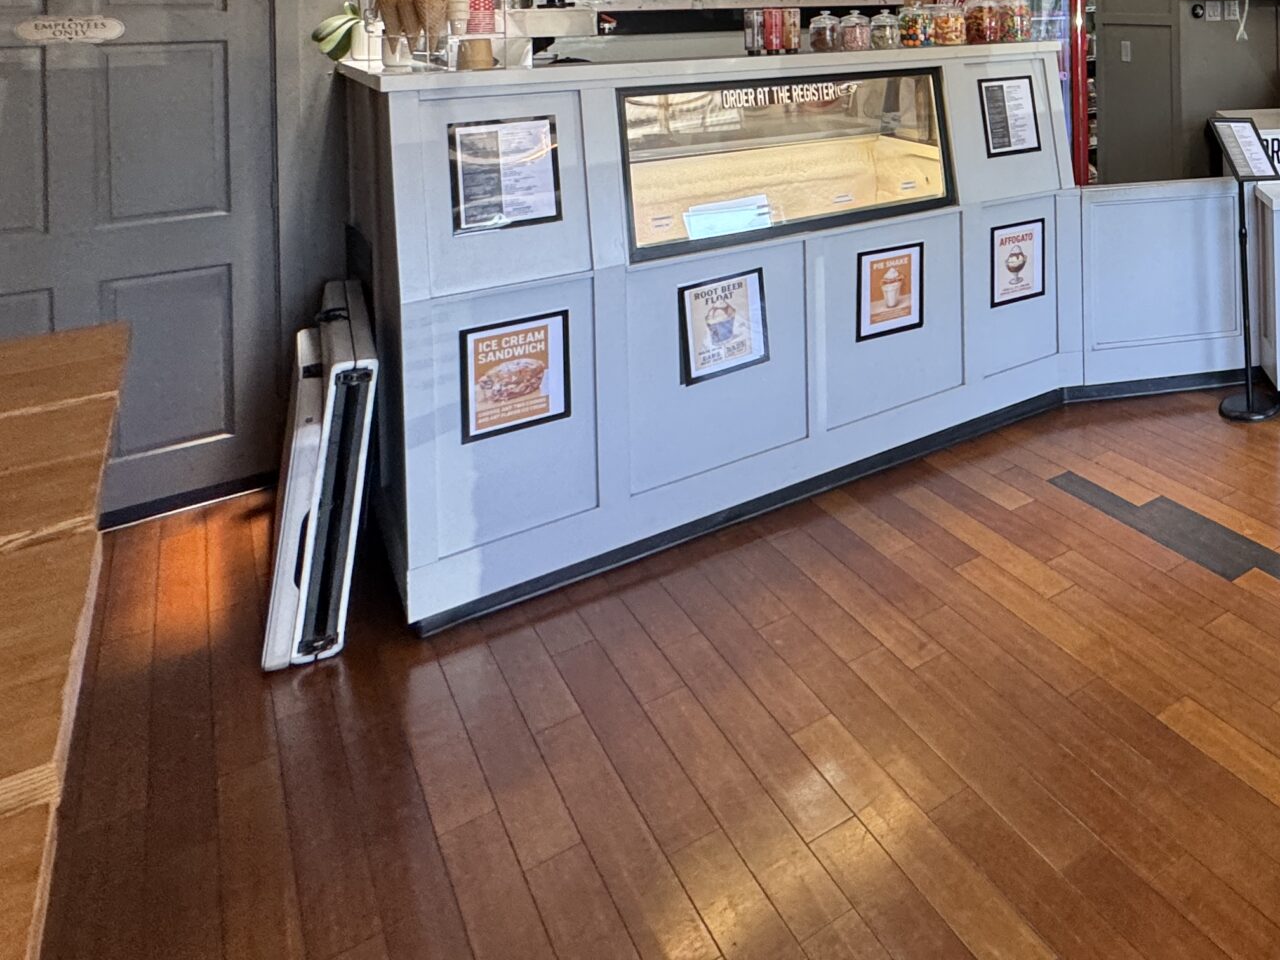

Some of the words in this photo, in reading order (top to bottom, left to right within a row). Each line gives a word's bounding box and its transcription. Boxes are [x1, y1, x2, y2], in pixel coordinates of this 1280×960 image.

[34, 22, 107, 30] EMPLOYEES
[52, 29, 88, 37] ONLY
[722, 88, 755, 108] ORDER
[757, 88, 770, 106] AT
[771, 84, 791, 104] THE
[792, 82, 835, 103] REGISTER
[999, 232, 1034, 247] AFFOGATO
[886, 257, 908, 268] SHAKE
[694, 287, 719, 301] ROOT
[721, 282, 743, 292] BEER
[705, 291, 734, 305] FLOAT
[478, 339, 498, 352] ICE
[502, 330, 545, 348] CREAM
[478, 341, 545, 364] SANDWICH
